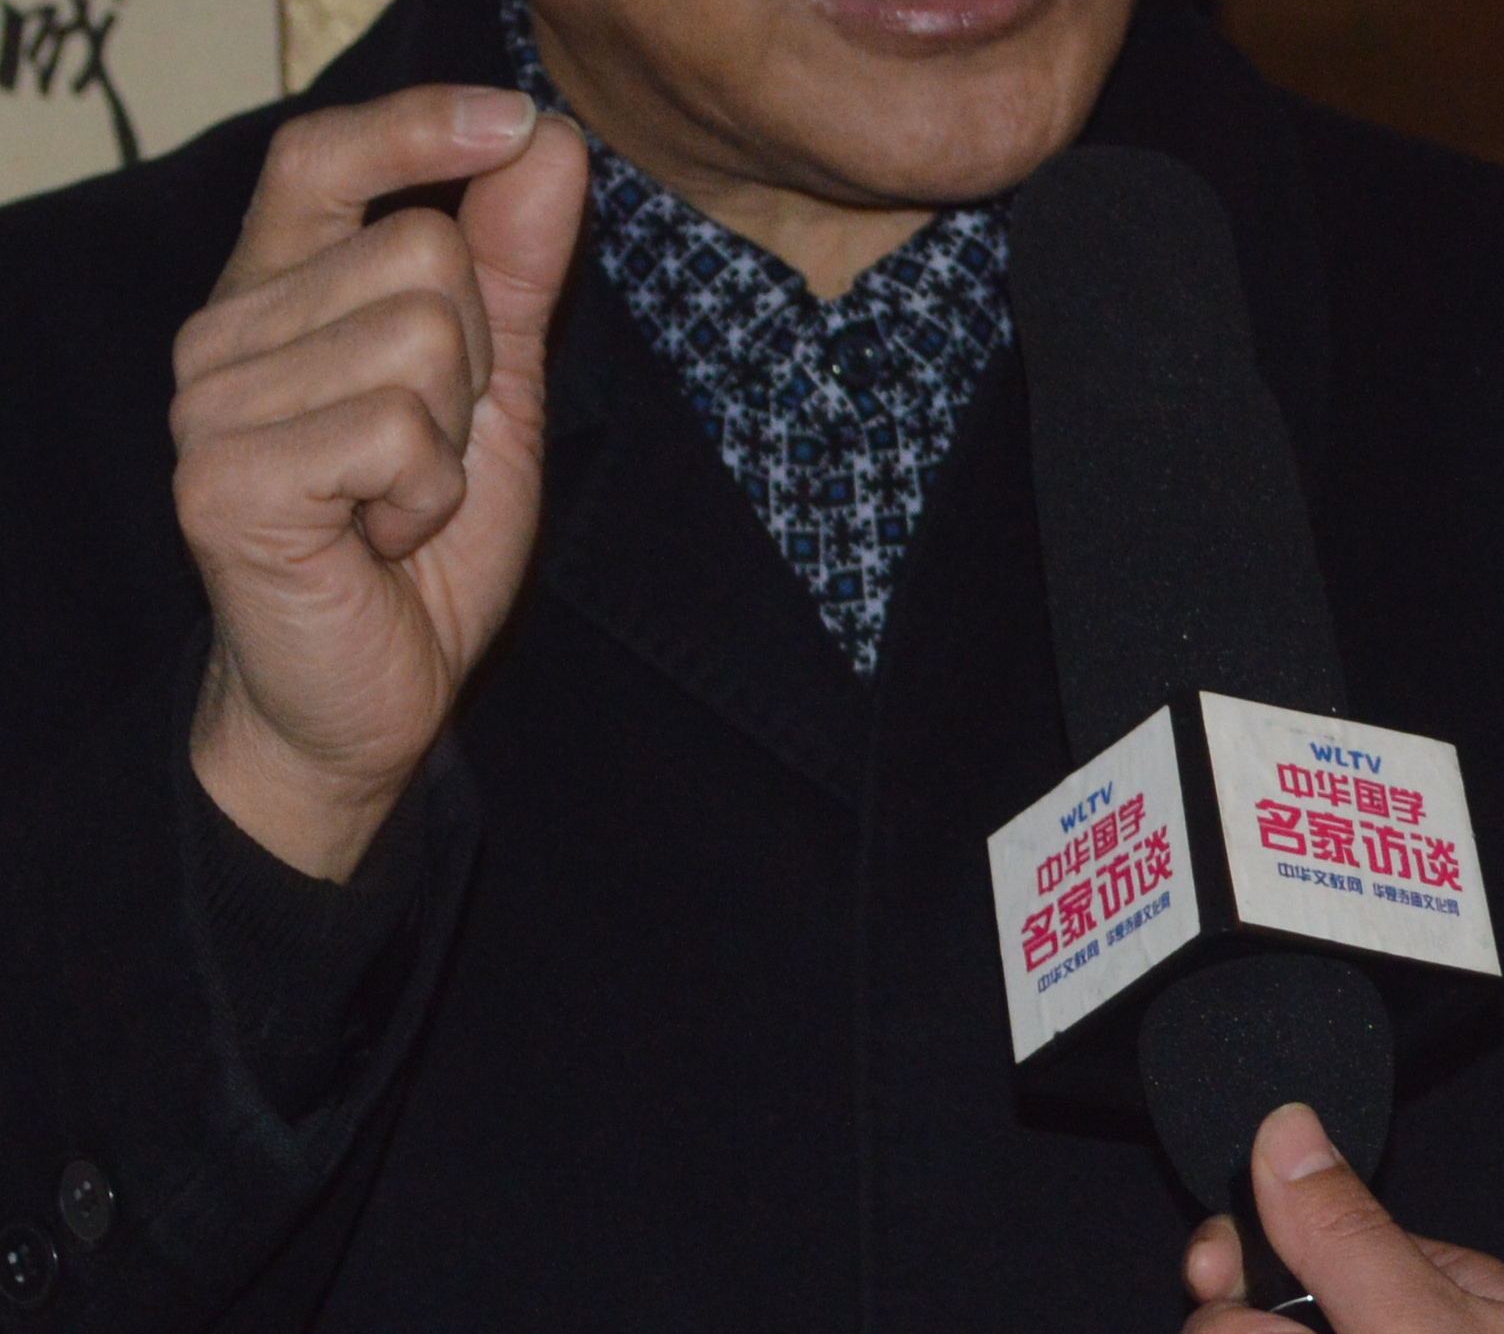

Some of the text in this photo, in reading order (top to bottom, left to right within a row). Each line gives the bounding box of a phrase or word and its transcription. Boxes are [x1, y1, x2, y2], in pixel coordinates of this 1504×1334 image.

[1276, 763, 1426, 825] 中华国学
[1310, 742, 1382, 774] WLTV
[1037, 793, 1146, 896] 中华国学
[1060, 781, 1112, 833] WLTV
[1255, 798, 1463, 891] 名家访谈
[1021, 825, 1173, 973] 名家访谈
